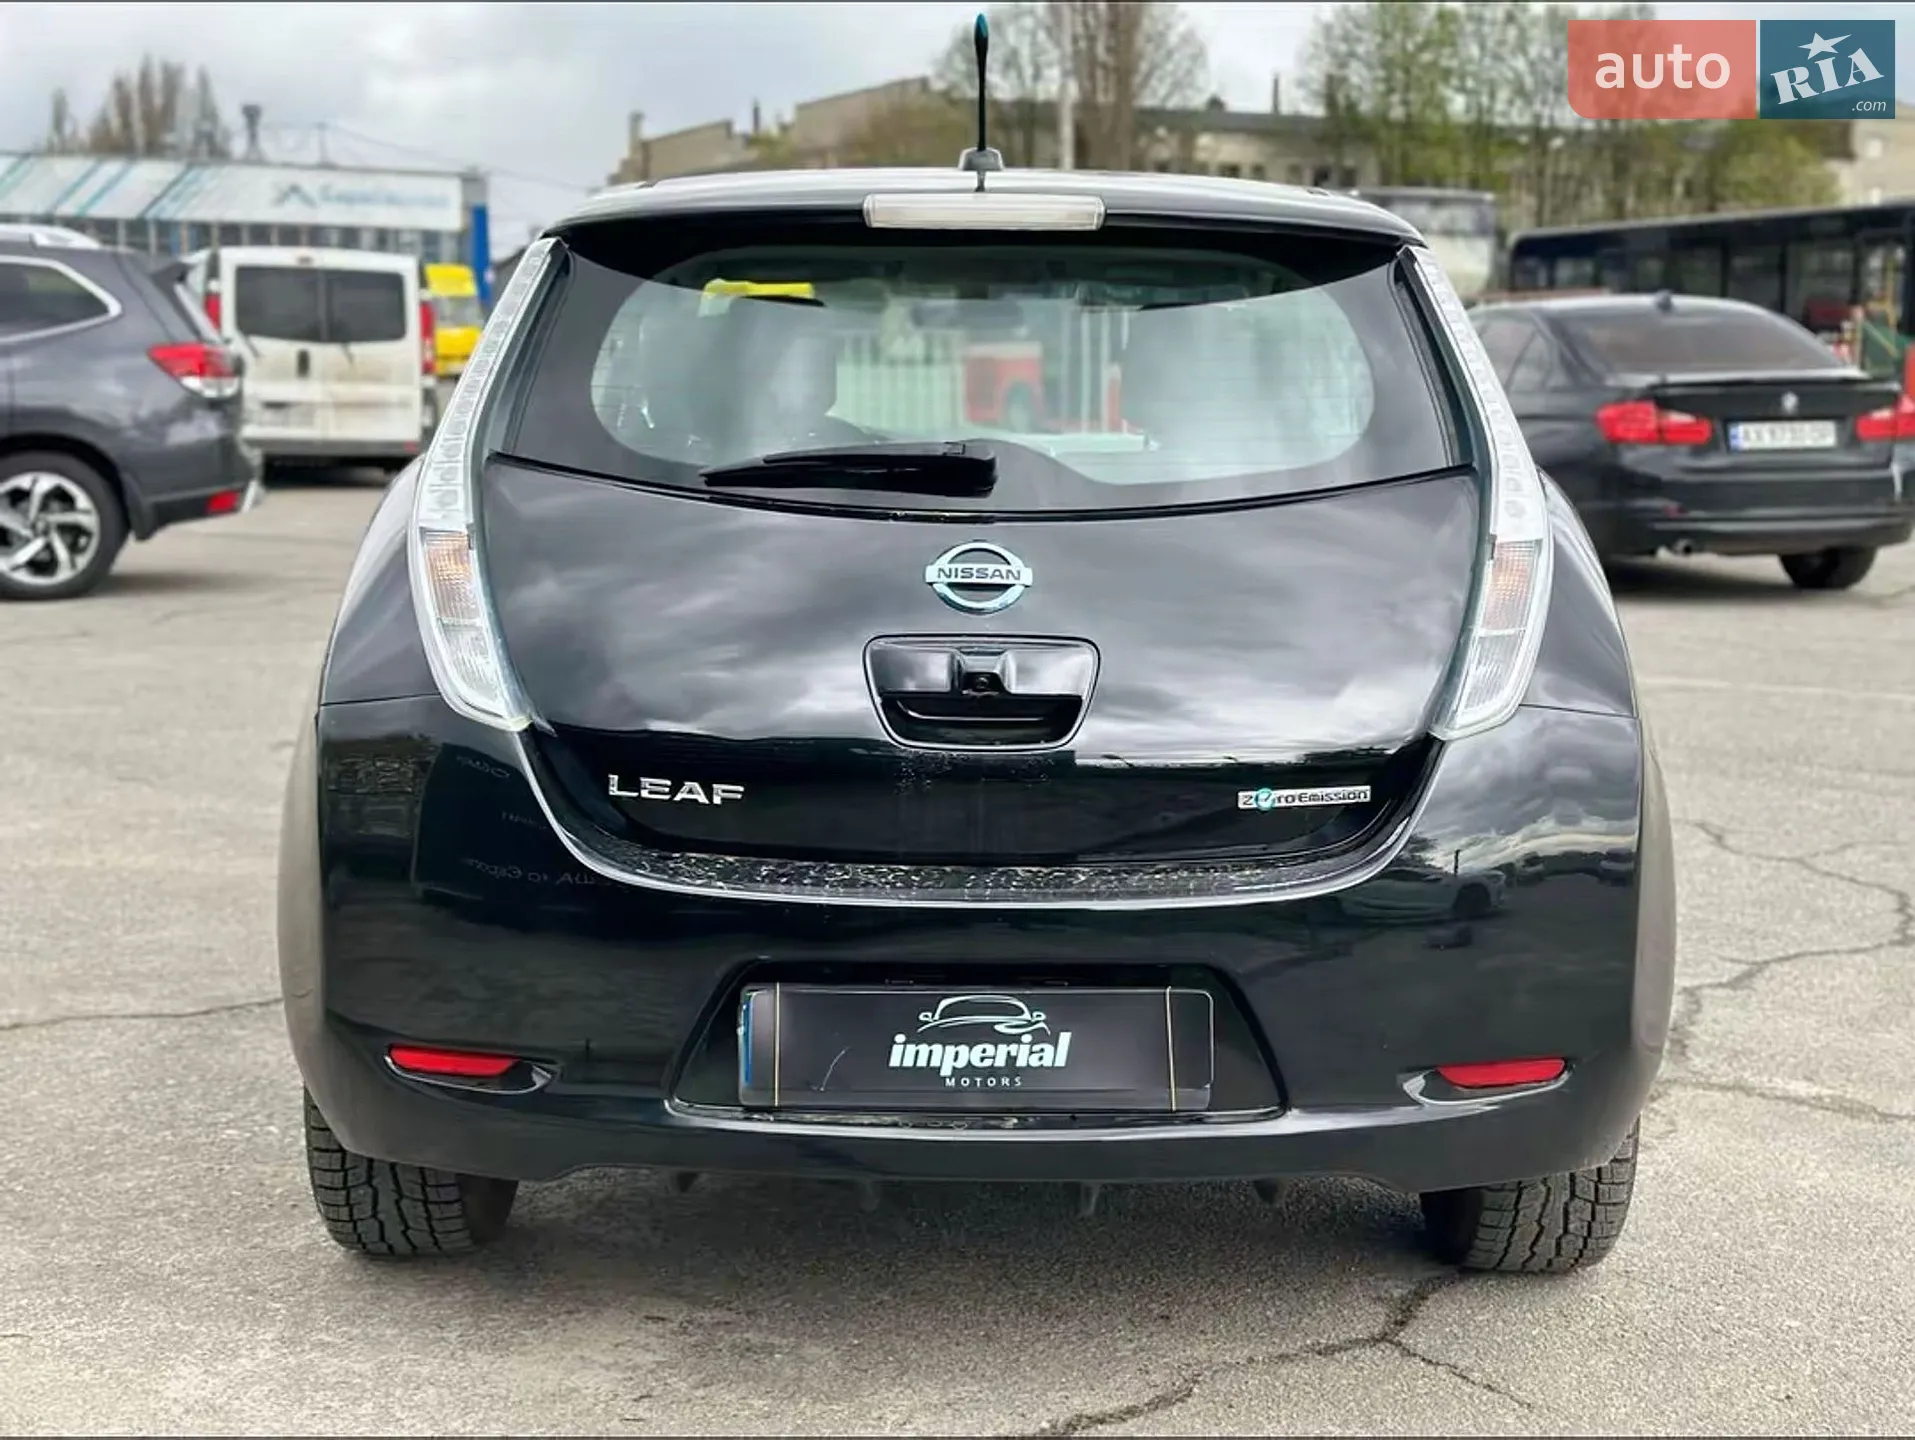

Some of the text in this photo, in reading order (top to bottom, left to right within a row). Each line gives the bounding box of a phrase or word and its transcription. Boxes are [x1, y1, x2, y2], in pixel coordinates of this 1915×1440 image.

[937, 567, 1021, 581] NISSAN
[608, 774, 745, 805] LEAF
[889, 1031, 1072, 1077] imperial
[945, 1076, 1022, 1087] MOTORS
